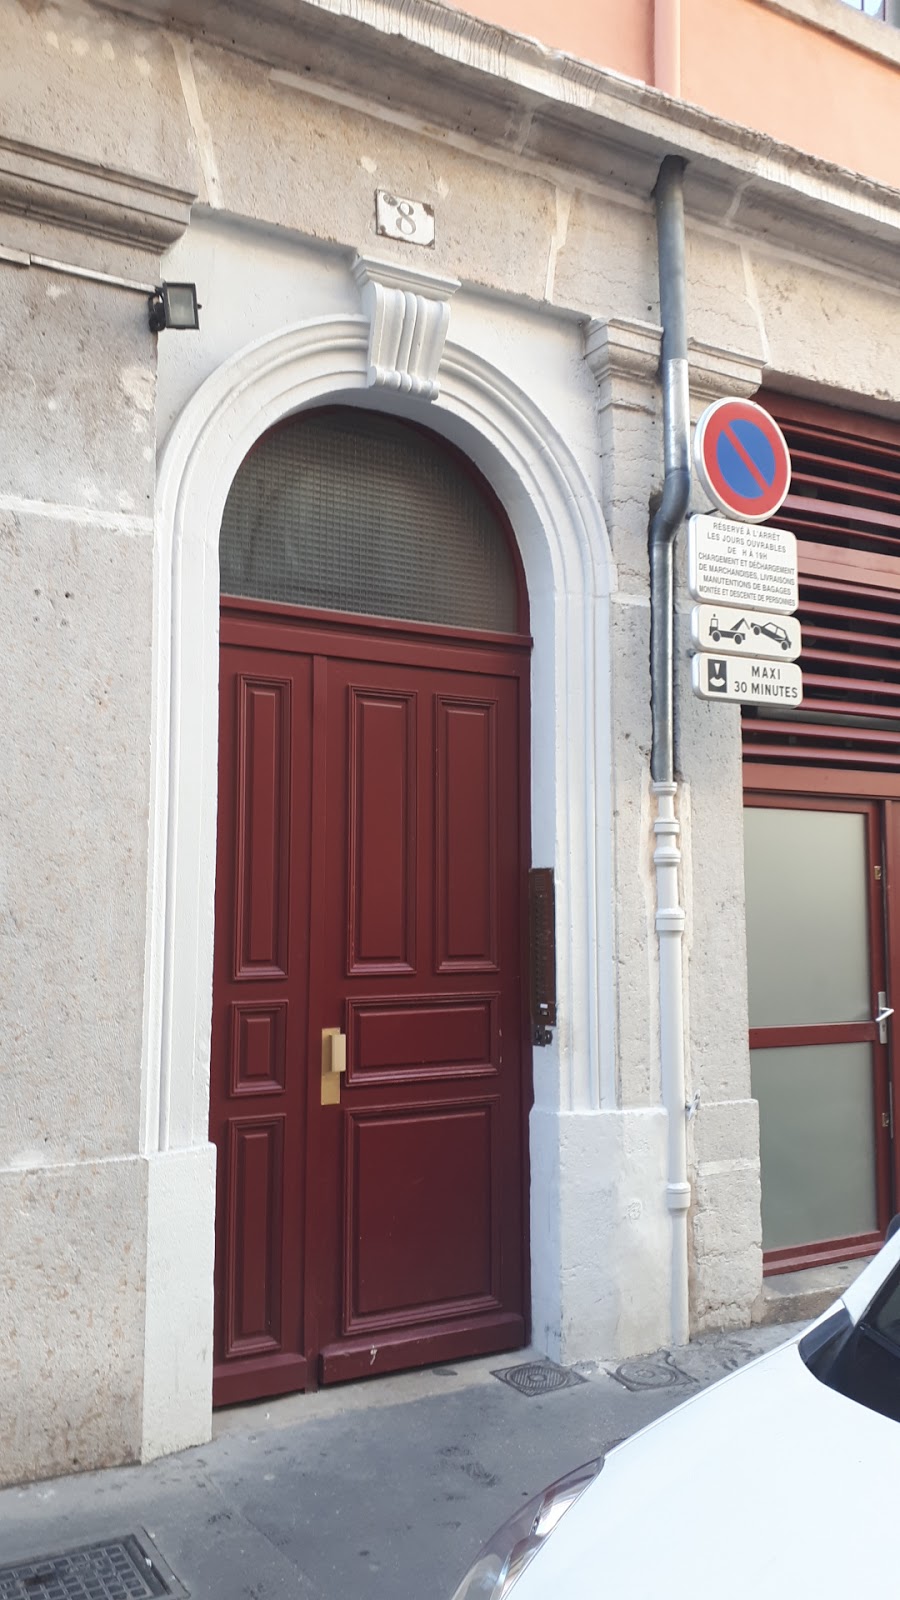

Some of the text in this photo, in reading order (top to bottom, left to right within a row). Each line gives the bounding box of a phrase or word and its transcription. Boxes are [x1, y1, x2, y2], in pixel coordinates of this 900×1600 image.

[396, 201, 417, 235] 8
[713, 521, 744, 535] RÉSERVÉ
[752, 529, 781, 541] L'ARRÊT
[707, 531, 787, 554] LES JOURS OUVRABLES
[727, 546, 737, 555] DE
[698, 552, 795, 575] CHARGEMENT ET DÉCHARGEMENT
[698, 562, 796, 586] DE MARCHANDISES, LIVRAISONS
[698, 585, 796, 607] MONTÉE ET DESCENTE DE PERSONNES
[703, 574, 791, 596] MANUTENTIONS DE BAGAGES
[751, 665, 781, 680] MAXI
[734, 681, 798, 698] 30 MINUTES
